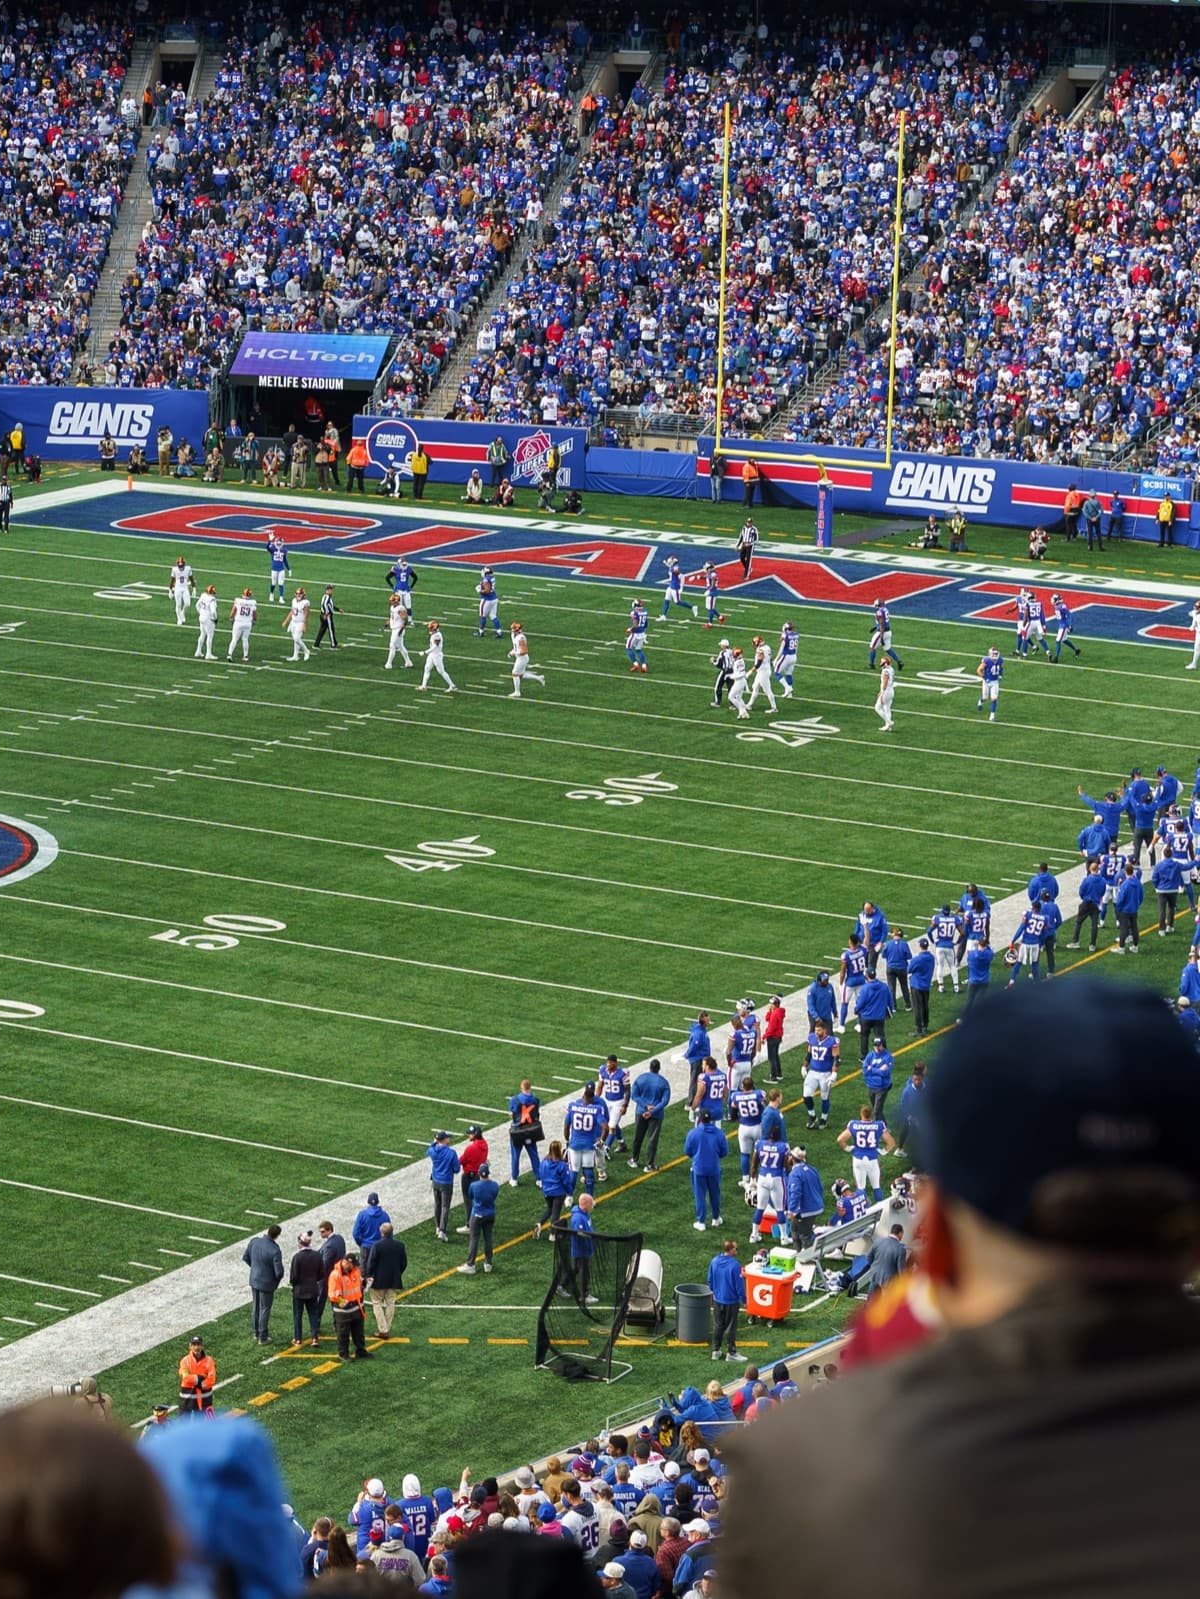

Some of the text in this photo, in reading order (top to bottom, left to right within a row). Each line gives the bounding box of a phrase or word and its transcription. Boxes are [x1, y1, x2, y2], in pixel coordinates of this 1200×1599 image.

[244, 347, 375, 364] HCLTech
[258, 375, 344, 390] METLIFE STADIUM
[49, 401, 155, 438] GIANTS
[375, 433, 407, 446] GIANTS
[889, 460, 996, 503] GIANTS
[1150, 480, 1163, 489] CBS
[936, 562, 1012, 574] OF
[1035, 572, 1113, 586] US
[990, 665, 1001, 676] 41
[735, 719, 841, 748] 20
[565, 777, 679, 806] 30
[383, 838, 497, 872] 40
[150, 913, 287, 951] 50
[938, 923, 956, 937] 30
[973, 919, 987, 932] 21
[1026, 919, 1045, 936] 39
[852, 959, 865, 974] 18
[741, 1039, 755, 1054] 12
[811, 1046, 828, 1061] 67
[604, 1080, 620, 1094] 26
[709, 1082, 724, 1099] 62
[521, 1104, 536, 1124] K
[738, 1101, 759, 1117] 68
[573, 1113, 593, 1131] 60
[856, 1131, 877, 1148] 64
[759, 1152, 780, 1168] 77
[752, 1283, 774, 1307] G
[408, 1514, 427, 1536] 12
[581, 1521, 600, 1551] 26
